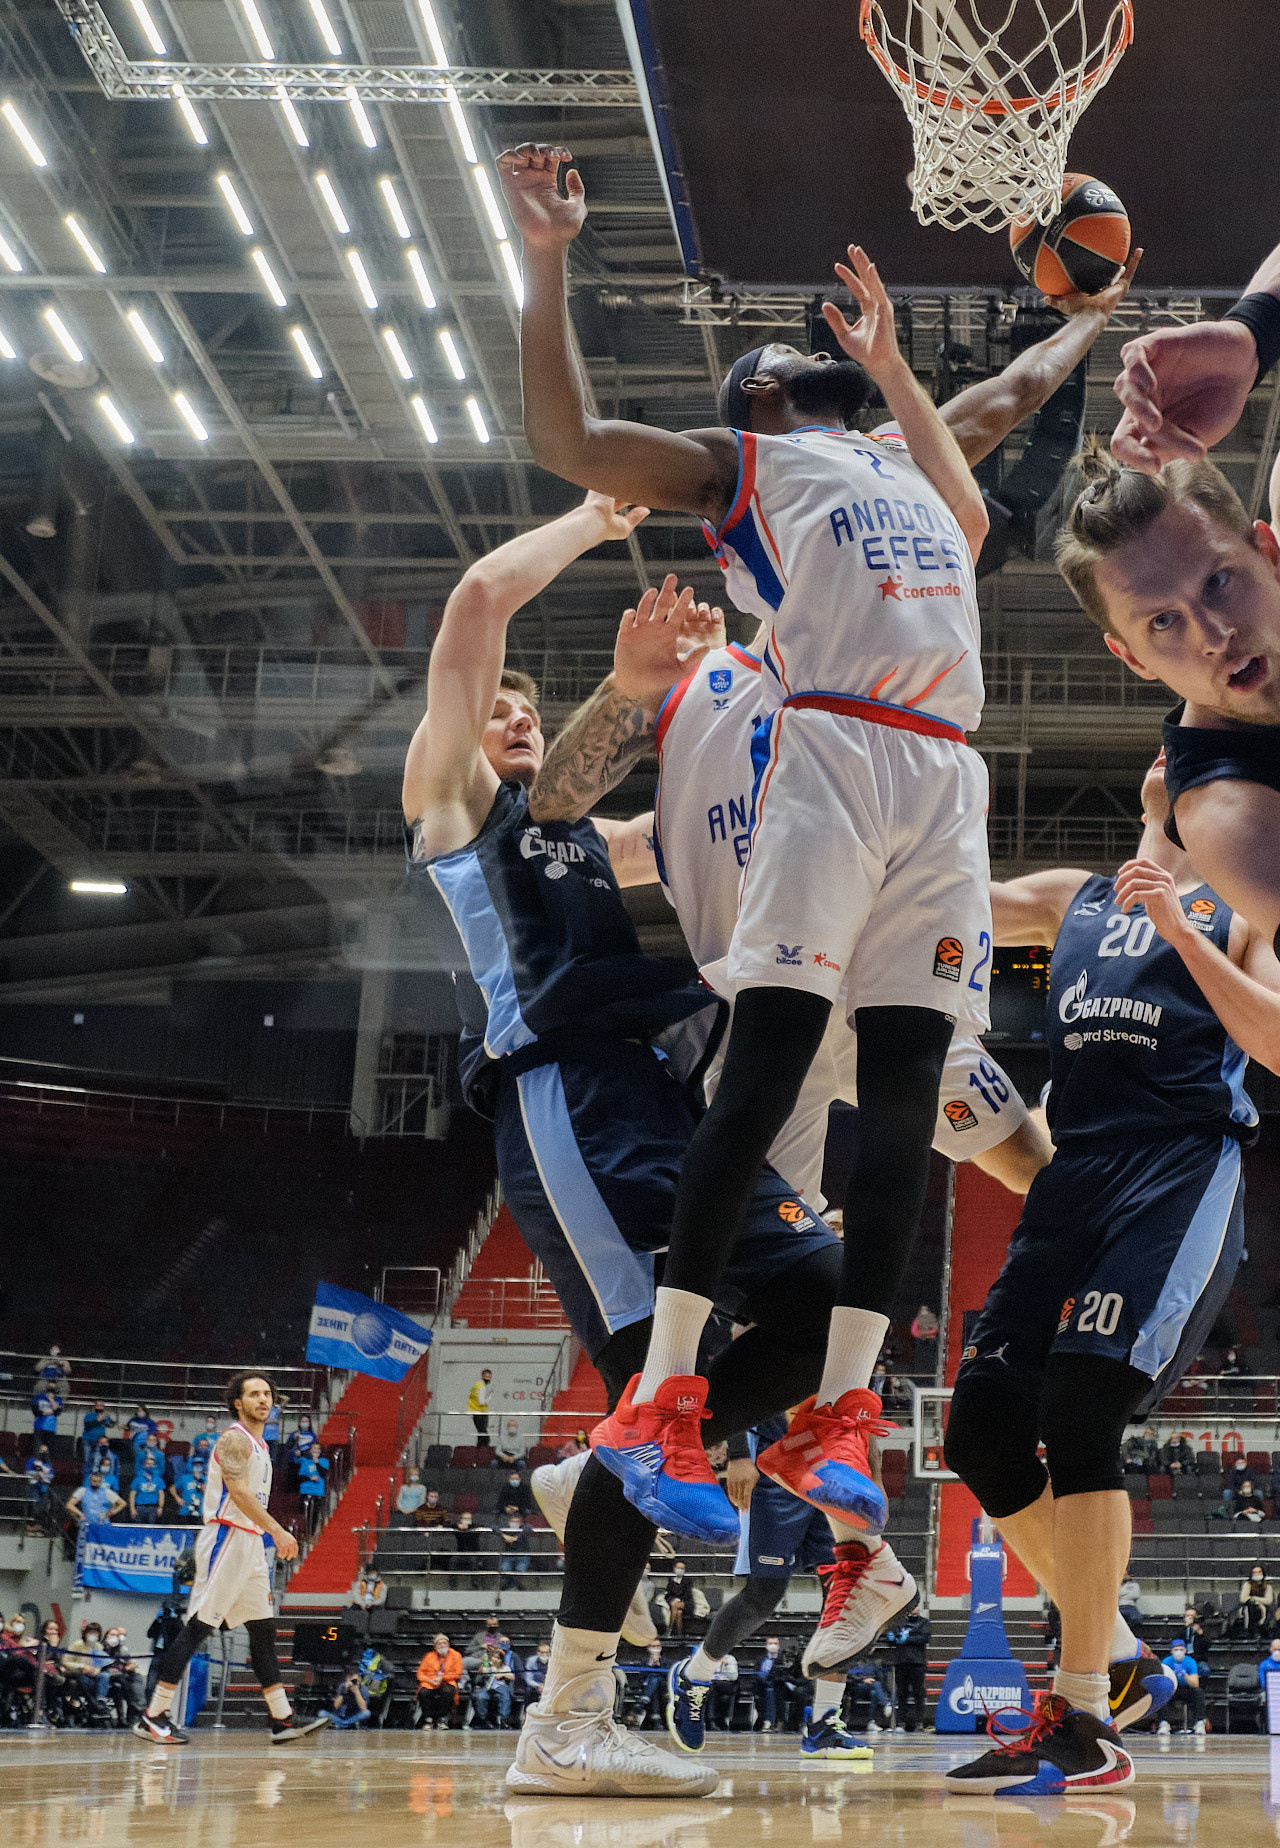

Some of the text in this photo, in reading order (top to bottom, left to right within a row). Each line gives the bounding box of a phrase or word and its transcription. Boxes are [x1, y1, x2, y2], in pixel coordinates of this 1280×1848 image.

[853, 448, 895, 480] 2
[862, 536, 963, 570] EFES
[903, 582, 963, 598] corendo
[1098, 913, 1157, 957] 20
[967, 930, 991, 992] 2
[1081, 997, 1163, 1027] GAZPROM
[1103, 1029, 1150, 1048] Stream
[969, 1056, 1010, 1115] 18
[1077, 1290, 1124, 1336] 20
[93, 1547, 151, 1567] НАШЕ
